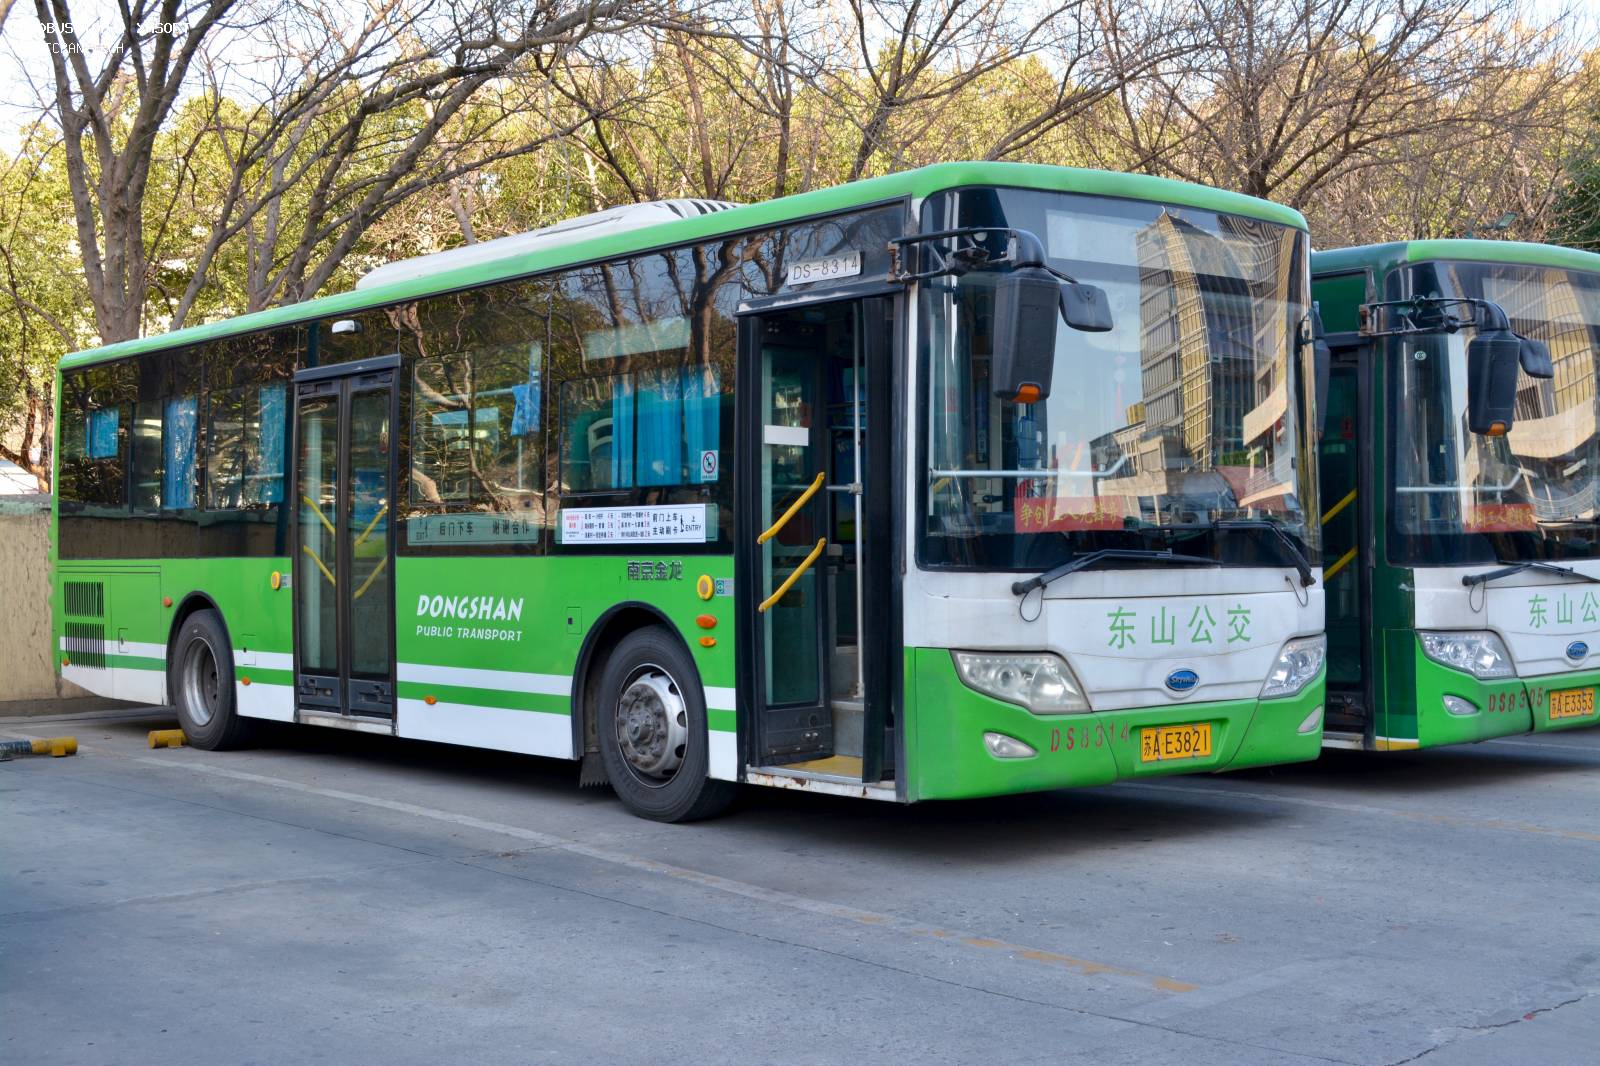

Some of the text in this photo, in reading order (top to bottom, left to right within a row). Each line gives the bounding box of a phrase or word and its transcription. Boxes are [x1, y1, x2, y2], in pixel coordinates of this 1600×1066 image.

[793, 255, 858, 281] DS-8314
[652, 511, 679, 523] 前门上车
[685, 524, 702, 532] ENTRY
[626, 559, 683, 581] 南京金龙
[416, 594, 524, 622] DONGSHAN
[1528, 591, 1600, 629] 东山公
[416, 625, 523, 642] PUBLIC TRANSPORT
[1107, 604, 1251, 650] 东山公交
[1050, 720, 1130, 752] DS8314
